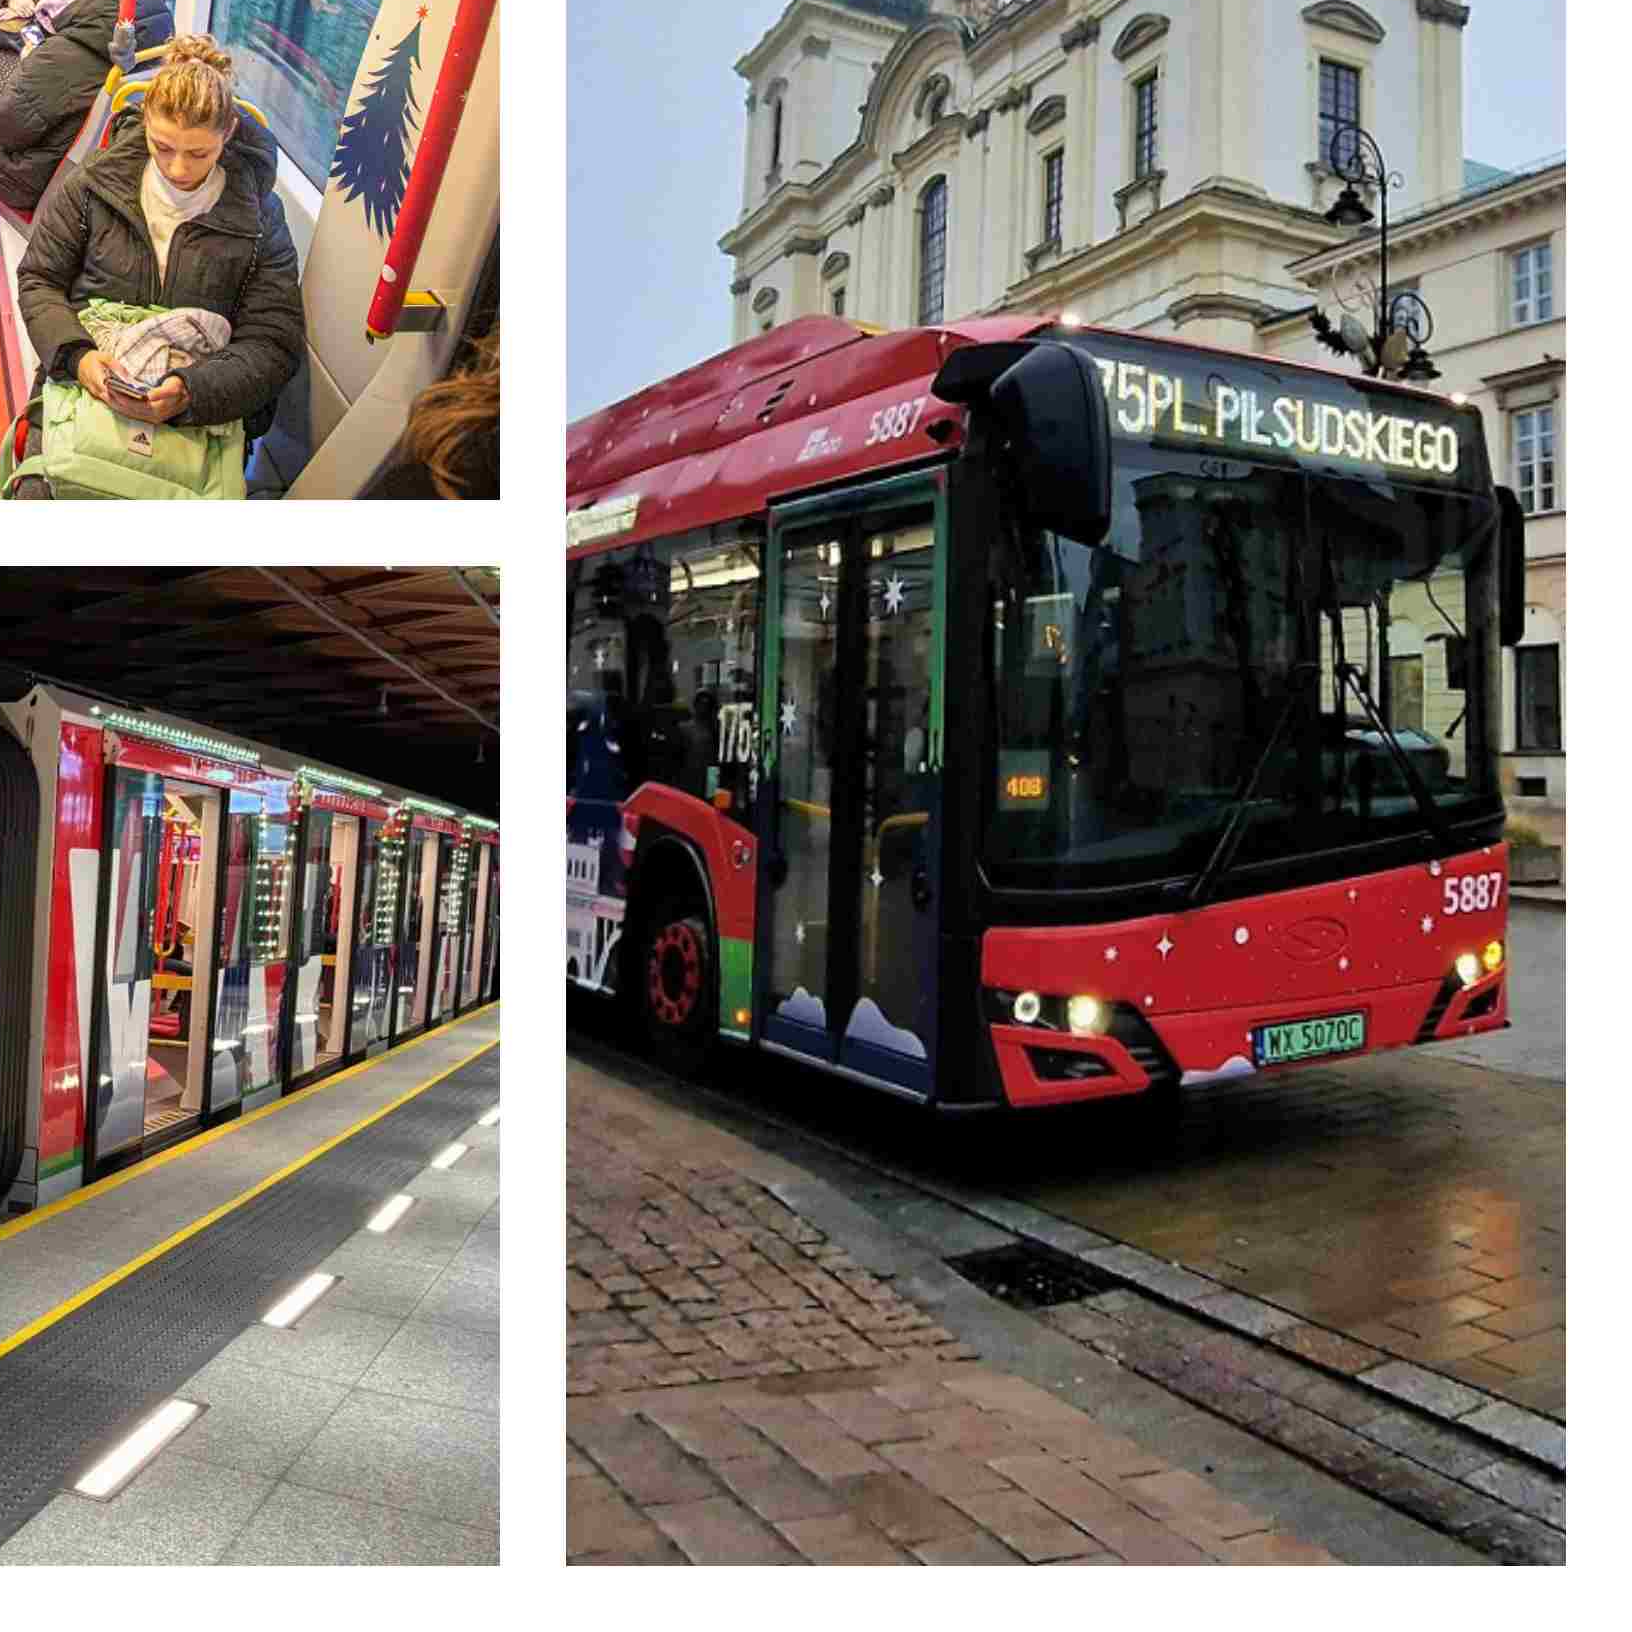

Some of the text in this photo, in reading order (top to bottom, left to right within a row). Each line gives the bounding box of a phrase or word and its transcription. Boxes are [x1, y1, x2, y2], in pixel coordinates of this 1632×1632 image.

[864, 396, 928, 448] 5887
[1215, 384, 1459, 474] PIŁSUDSKIEGO
[1443, 872, 1502, 915] 5887
